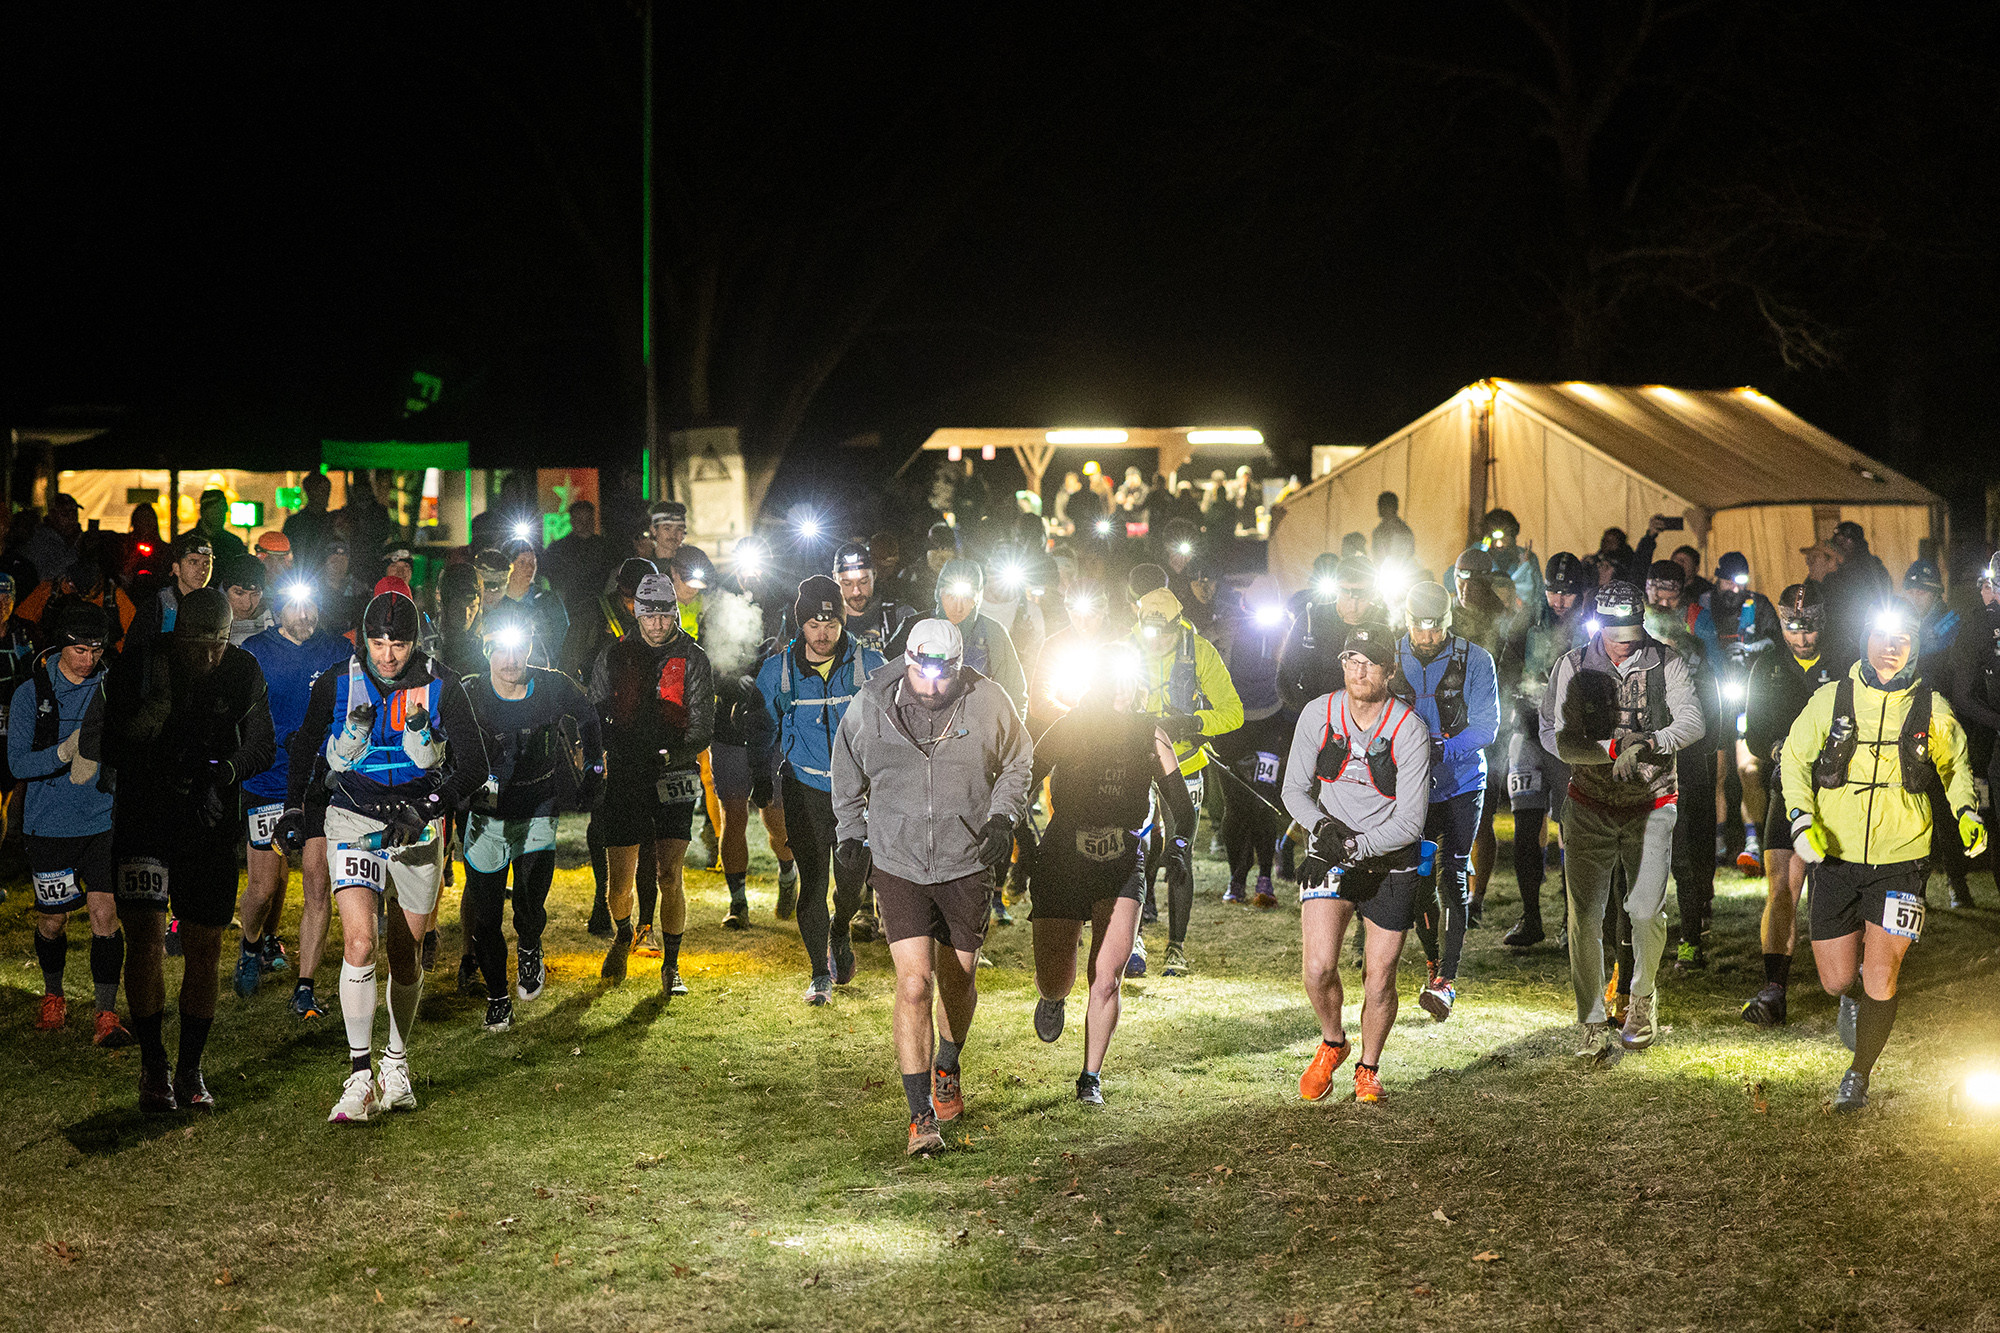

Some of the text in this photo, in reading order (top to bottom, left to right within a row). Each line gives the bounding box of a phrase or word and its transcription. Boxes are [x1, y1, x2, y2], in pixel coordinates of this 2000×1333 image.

[666, 780, 695, 798] 514
[1511, 774, 1532, 792] 517
[1085, 834, 1118, 857] 504
[345, 857, 381, 883] 590
[38, 882, 70, 900] 542
[125, 870, 163, 893] 599
